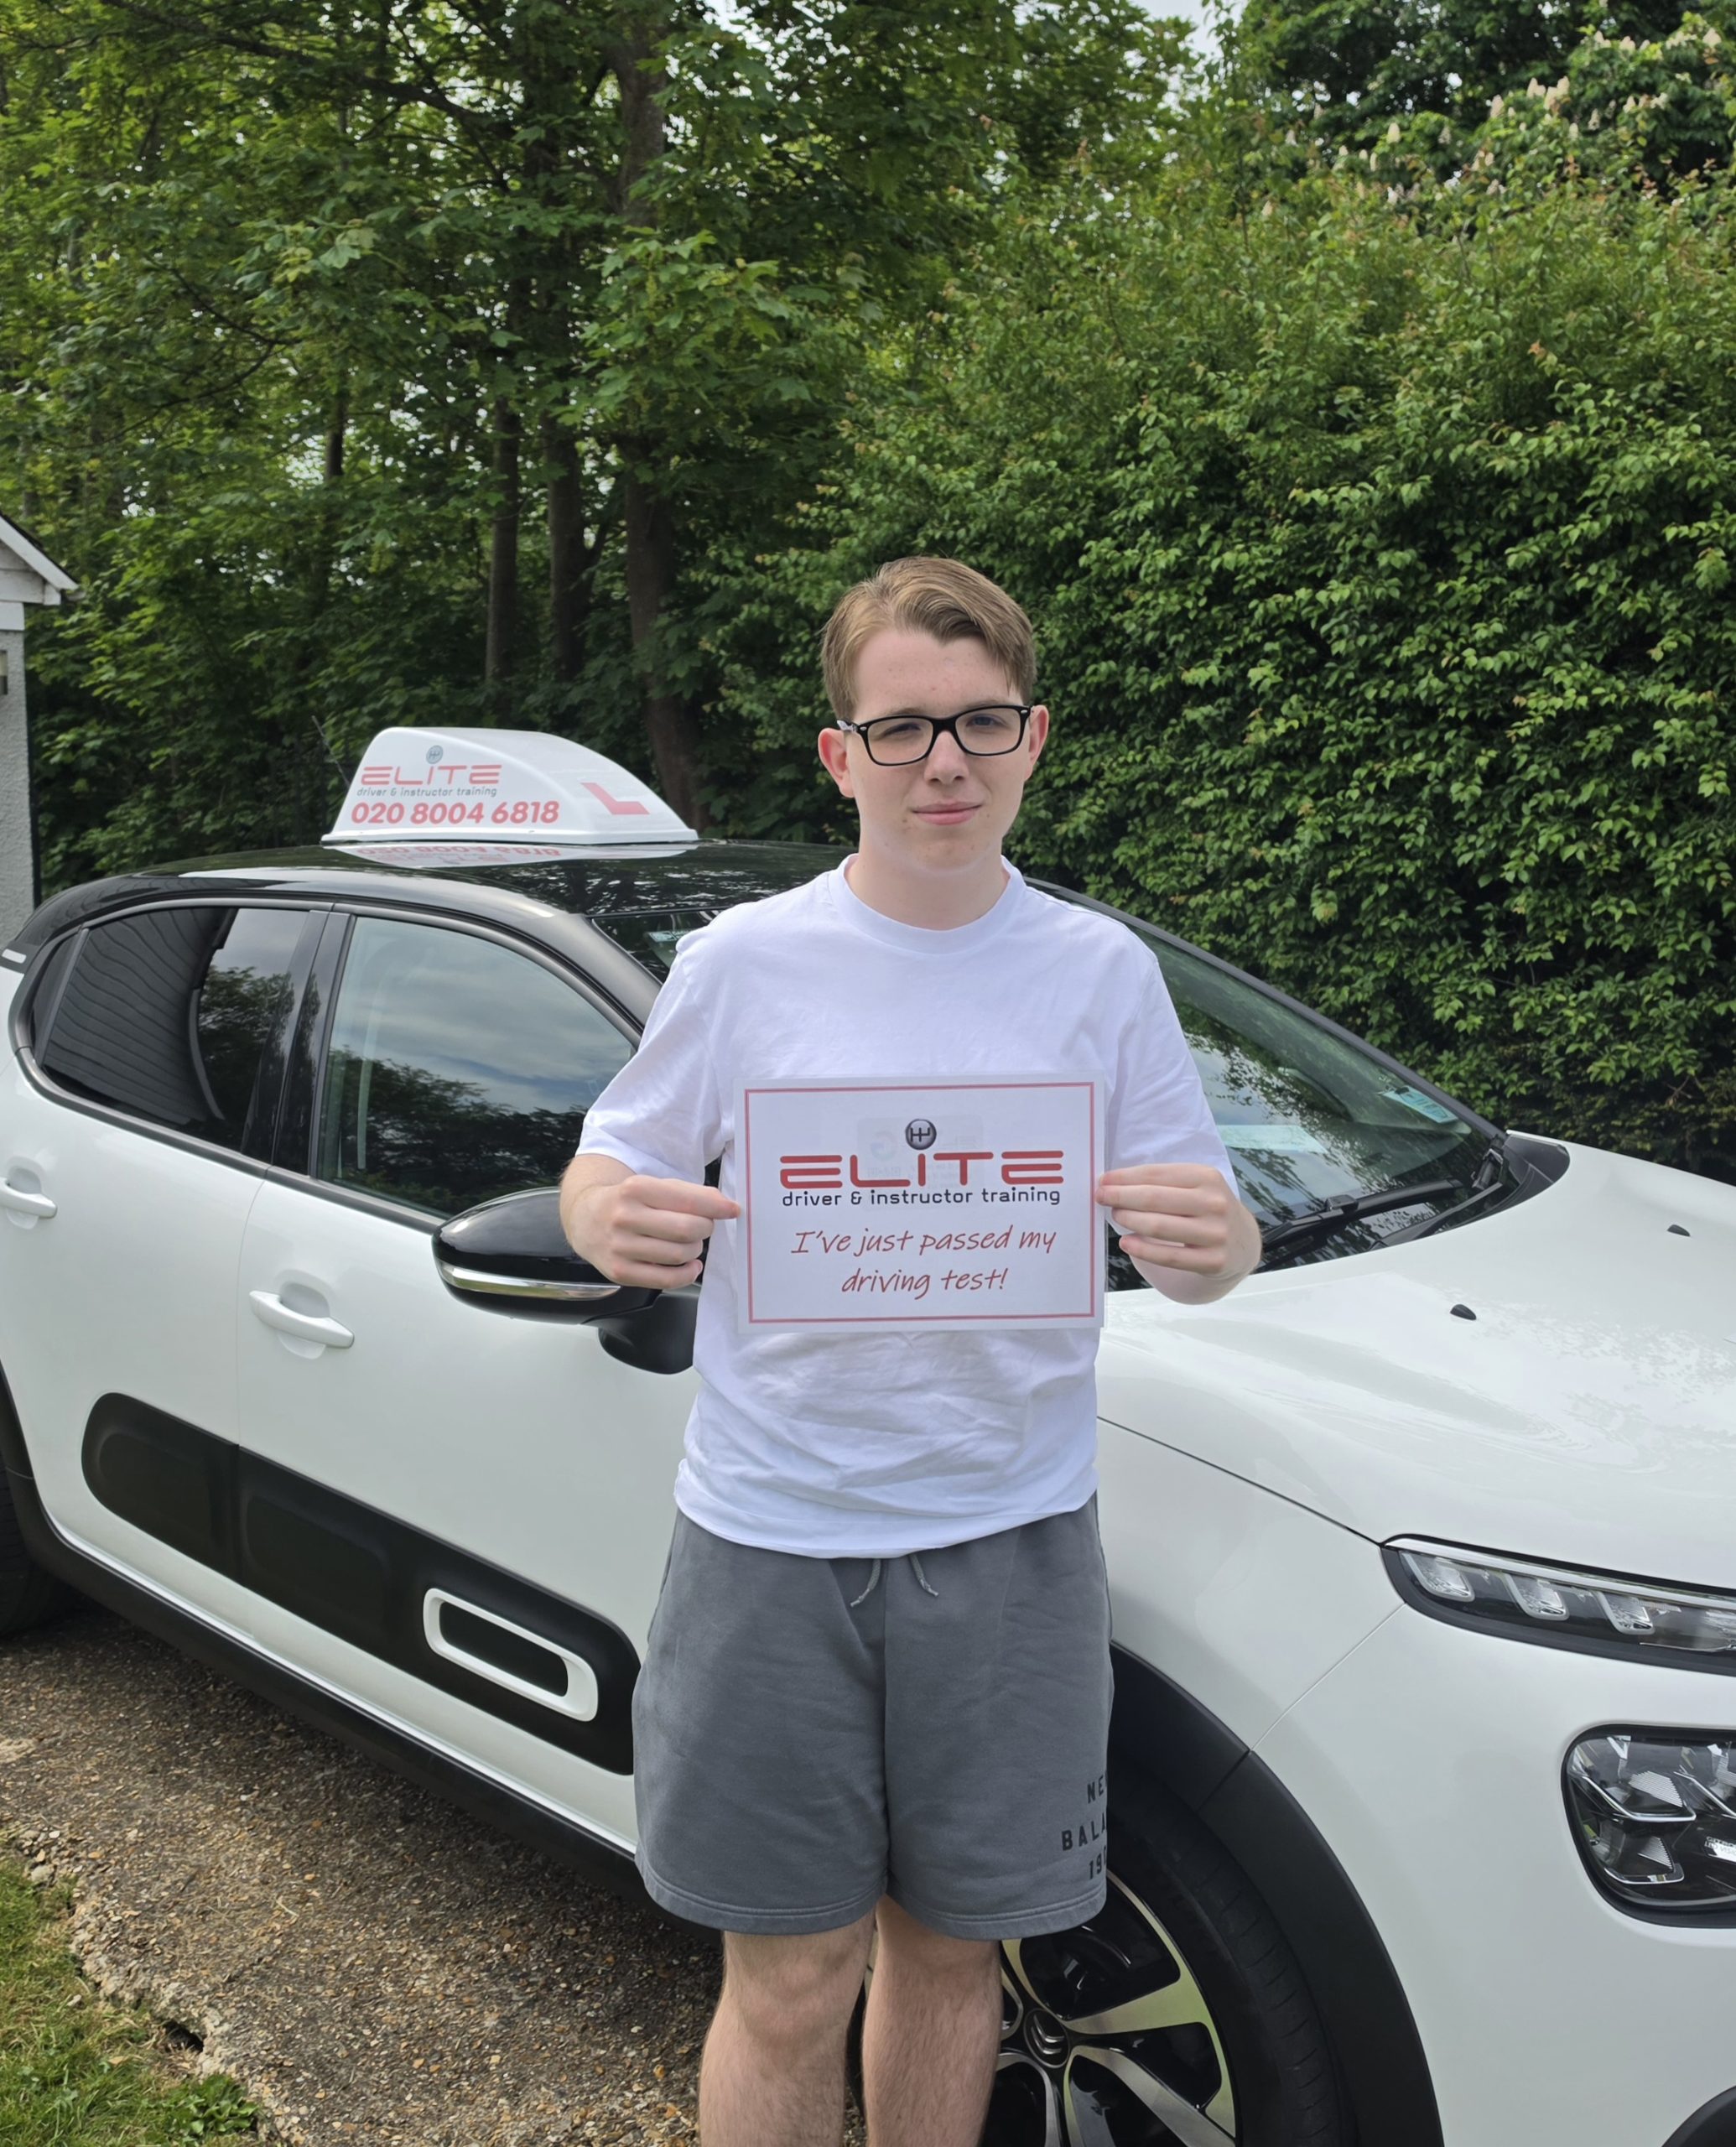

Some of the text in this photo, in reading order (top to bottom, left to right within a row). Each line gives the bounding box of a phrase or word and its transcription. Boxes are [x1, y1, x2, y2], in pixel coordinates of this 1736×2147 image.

[361, 764, 502, 786] ELITE
[356, 786, 497, 798] driver & instructor training
[351, 800, 560, 825] 020 8004 6818
[780, 1151, 1064, 1189] ELITE
[782, 1186, 1060, 1207] driver & instructor training
[791, 1224, 1057, 1257] I've just passed my
[841, 1268, 1008, 1300] driving test!
